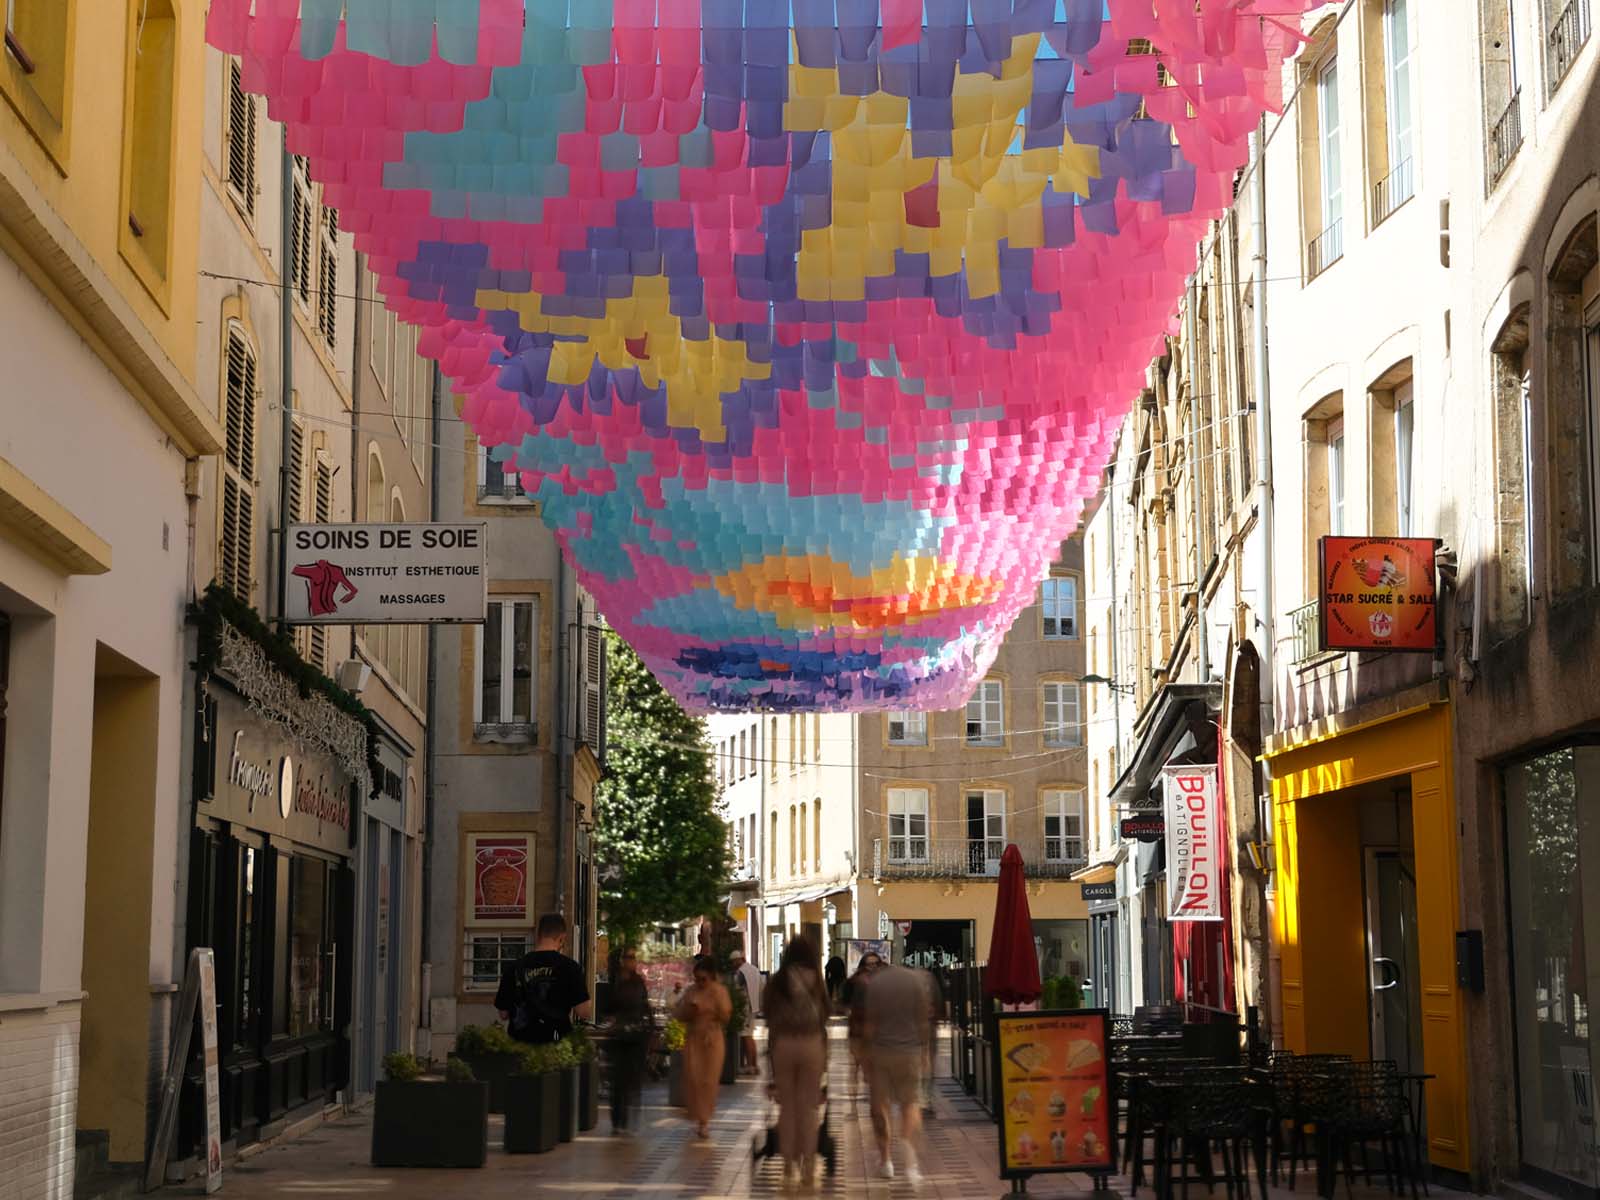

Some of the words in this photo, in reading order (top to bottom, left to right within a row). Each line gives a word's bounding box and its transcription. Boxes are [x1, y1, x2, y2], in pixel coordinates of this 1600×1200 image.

[296, 530, 369, 549] SOINS
[380, 530, 411, 549] DE
[422, 529, 478, 549] SOIE
[345, 566, 398, 577] INSTITUT
[406, 565, 479, 577] ESTHETIQUE
[380, 594, 445, 604] MASSAGES
[1327, 593, 1353, 604] STAR
[1358, 592, 1392, 604] SUCRÉ
[1397, 595, 1405, 604] &
[1085, 887, 1113, 896] CAROLL
